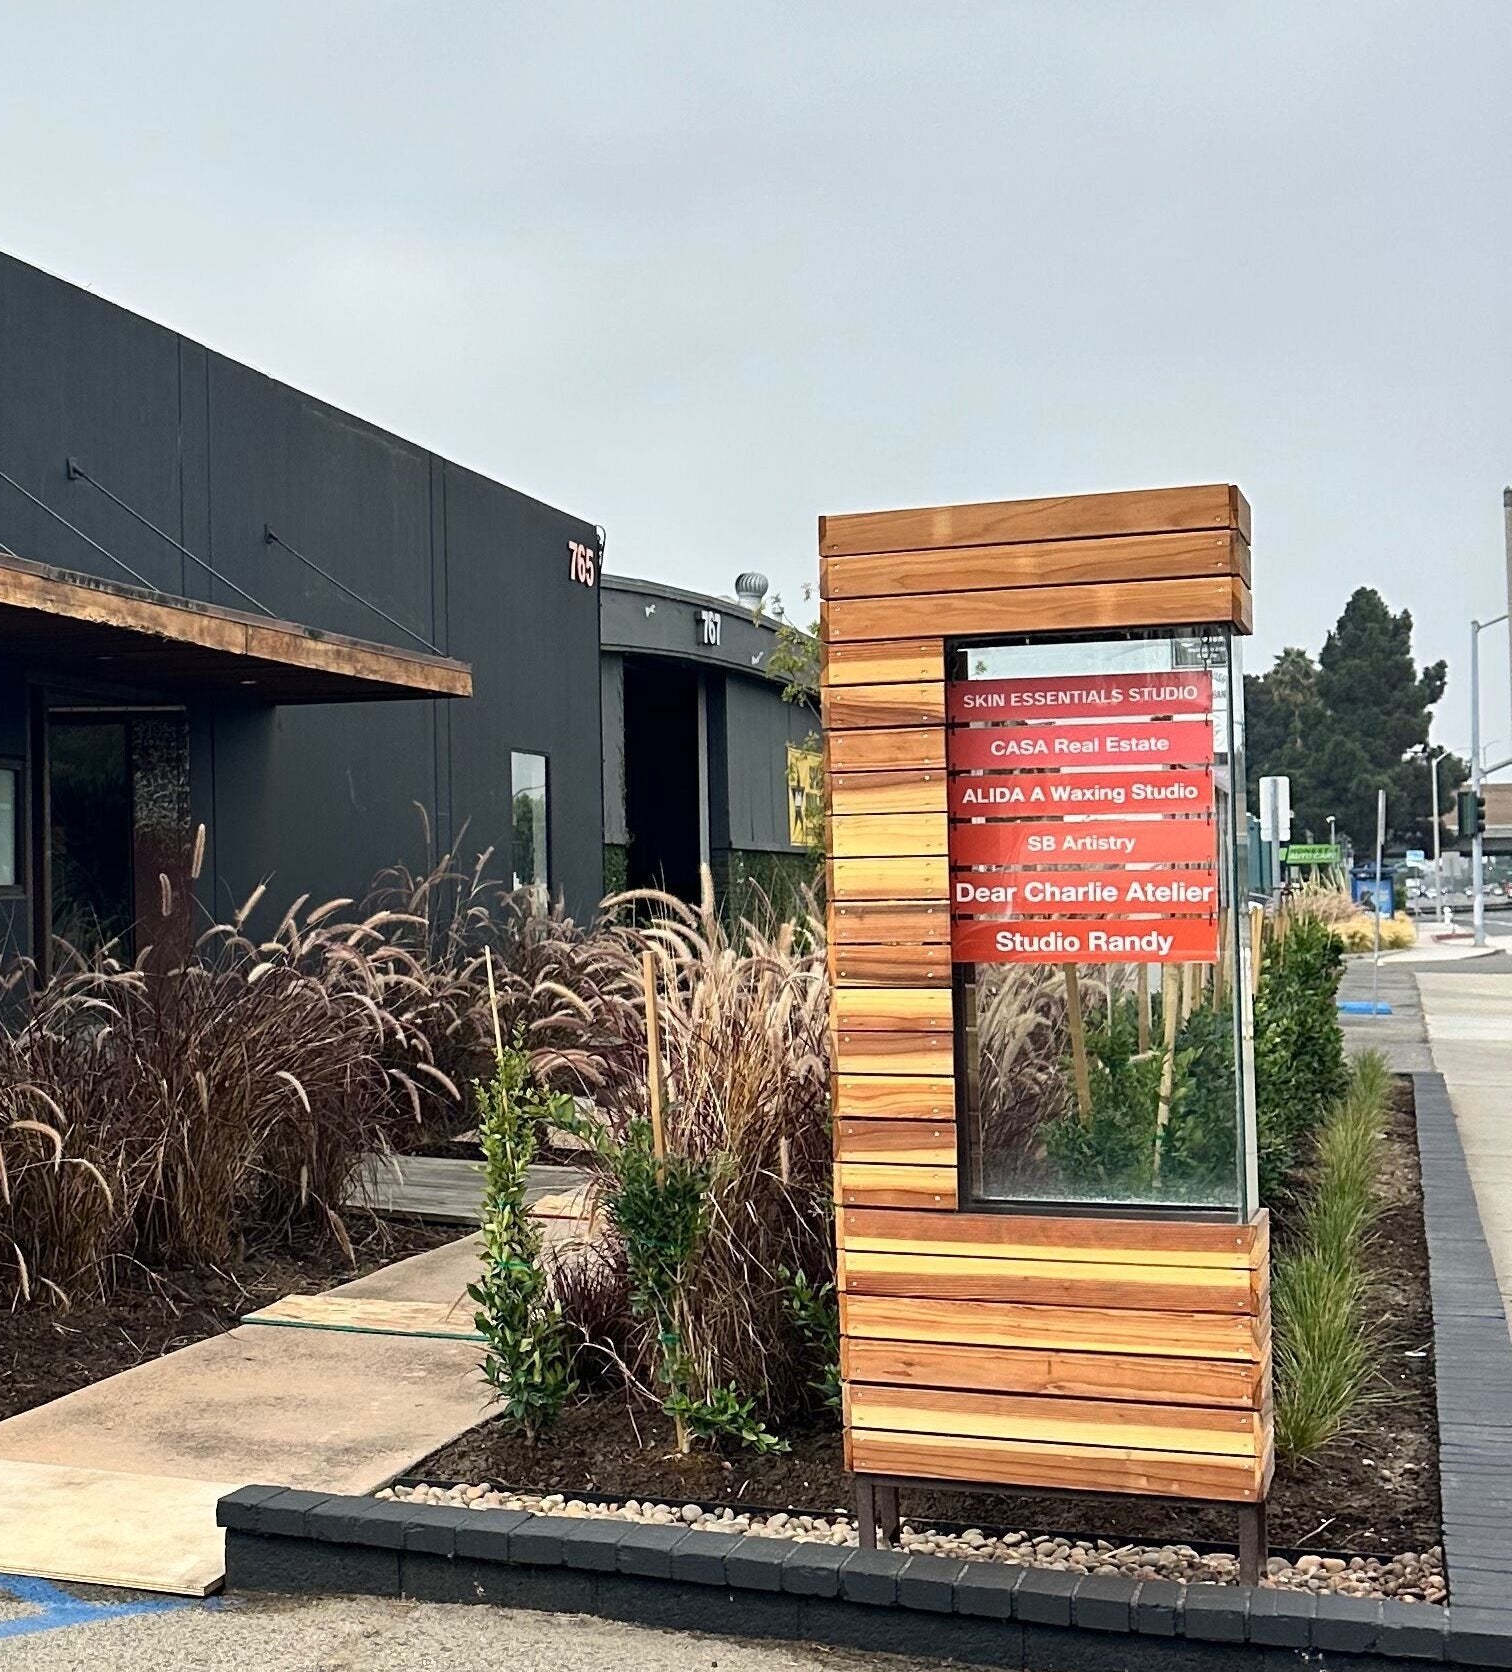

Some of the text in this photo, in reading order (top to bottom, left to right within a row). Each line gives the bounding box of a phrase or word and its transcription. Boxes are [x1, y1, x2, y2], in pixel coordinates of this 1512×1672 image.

[568, 540, 595, 587] 765
[701, 610, 721, 646] 767
[964, 694, 1004, 708] SKIN
[1011, 689, 1123, 707] ESSENTIALS
[1129, 686, 1198, 702] STUDIO
[991, 736, 1169, 756] CASA Real Estate
[962, 783, 1198, 804] ALIDA A Waxing Studio
[1027, 835, 1136, 853] SB Artistry
[956, 882, 1214, 902] Dear Charlie Atelier
[996, 930, 1173, 954] Studio Randy
